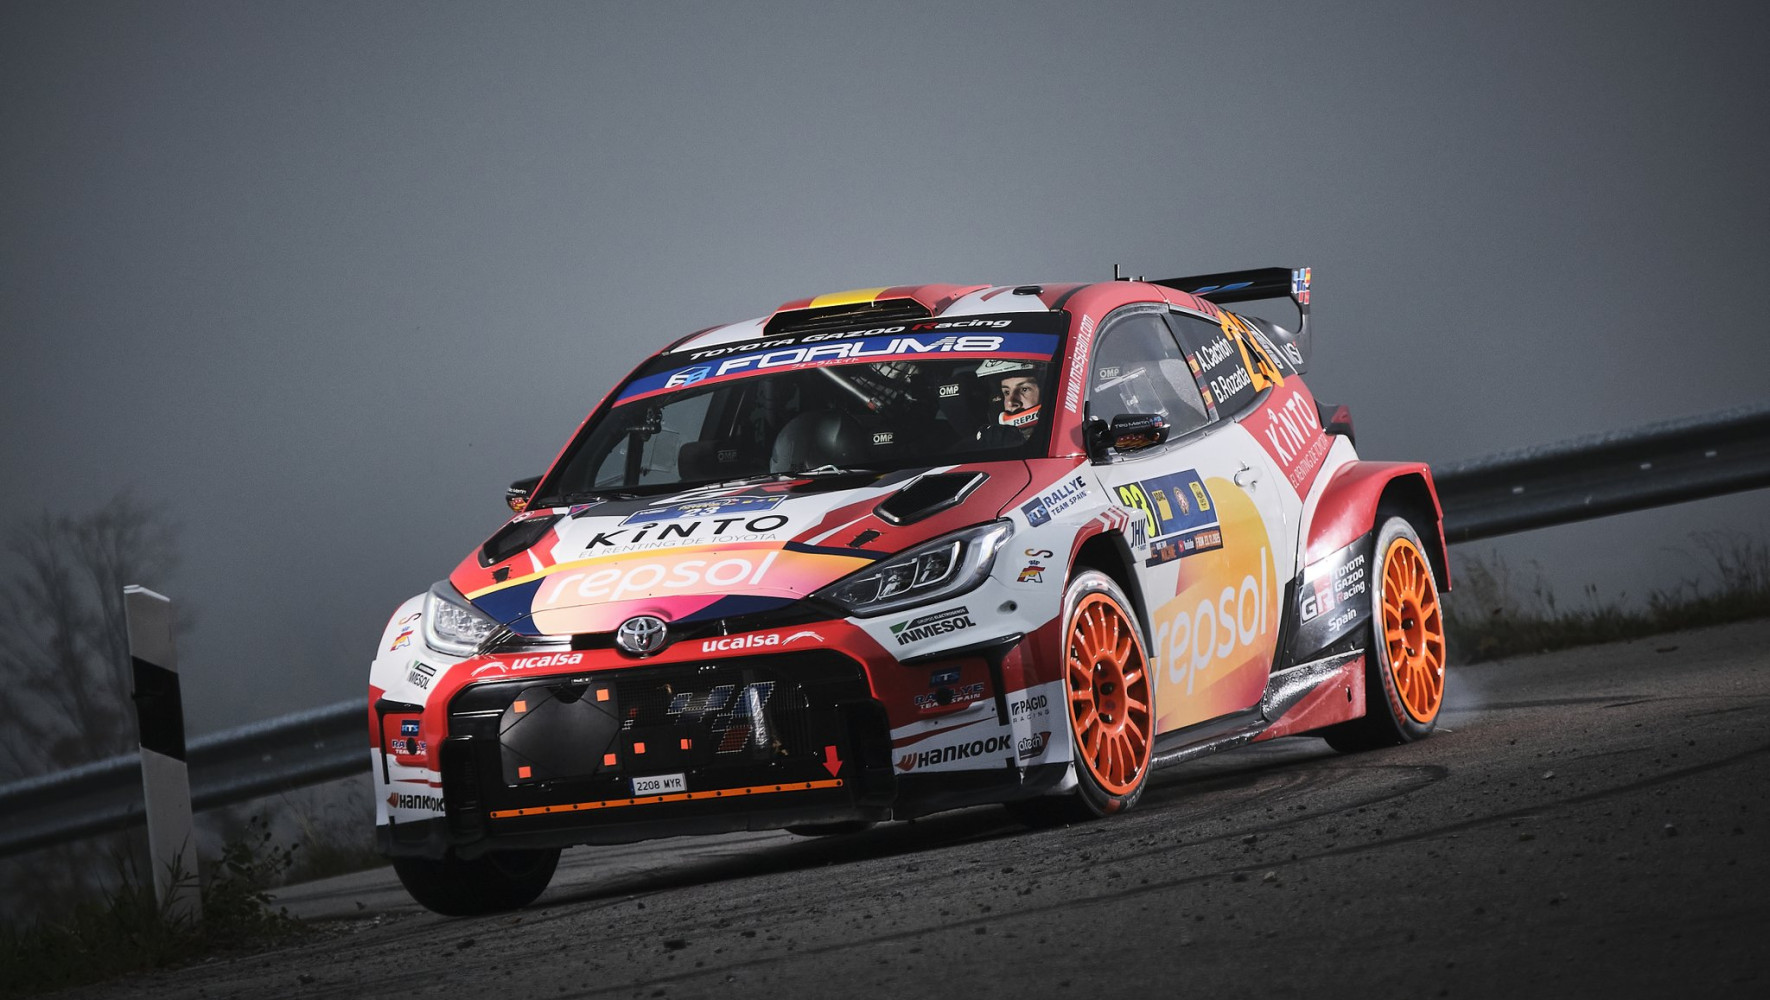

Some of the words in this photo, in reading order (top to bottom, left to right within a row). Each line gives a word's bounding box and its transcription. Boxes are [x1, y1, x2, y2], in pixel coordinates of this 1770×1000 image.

[690, 338, 796, 361] TOYOTA
[801, 325, 906, 344] GAZOO
[911, 319, 1013, 331] Racing
[715, 336, 1004, 376] FORUM8
[1064, 314, 1094, 414] www.msispain.com
[1195, 335, 1234, 373] A.Cachón
[1100, 368, 1119, 378] OMP
[1210, 364, 1251, 403] B.Rozada
[939, 386, 959, 396] OMP
[873, 433, 894, 444] OMP
[1043, 476, 1086, 508] RALLYE
[1051, 501, 1069, 516] TEAM
[1070, 490, 1087, 505] SPAIN
[1131, 518, 1146, 548] JHK
[579, 550, 595, 558] EL
[601, 540, 676, 555] RENTING
[682, 537, 705, 546] DE
[712, 533, 777, 543] TOYOTA
[547, 551, 780, 603] repsol
[1335, 554, 1365, 580] TOYOTA
[1335, 568, 1364, 592] GAZOO
[1337, 581, 1366, 604] Racing
[1154, 546, 1267, 697] repsol
[1328, 608, 1357, 632] Spain
[702, 632, 781, 653] ucalsa
[511, 652, 584, 671] ucalsa
[914, 682, 984, 706] RALYE
[1020, 695, 1048, 713] PAGID
[402, 724, 419, 732] RTS
[1013, 709, 1050, 723] RACING
[636, 780, 660, 791] 2208
[664, 779, 682, 789] MYR
